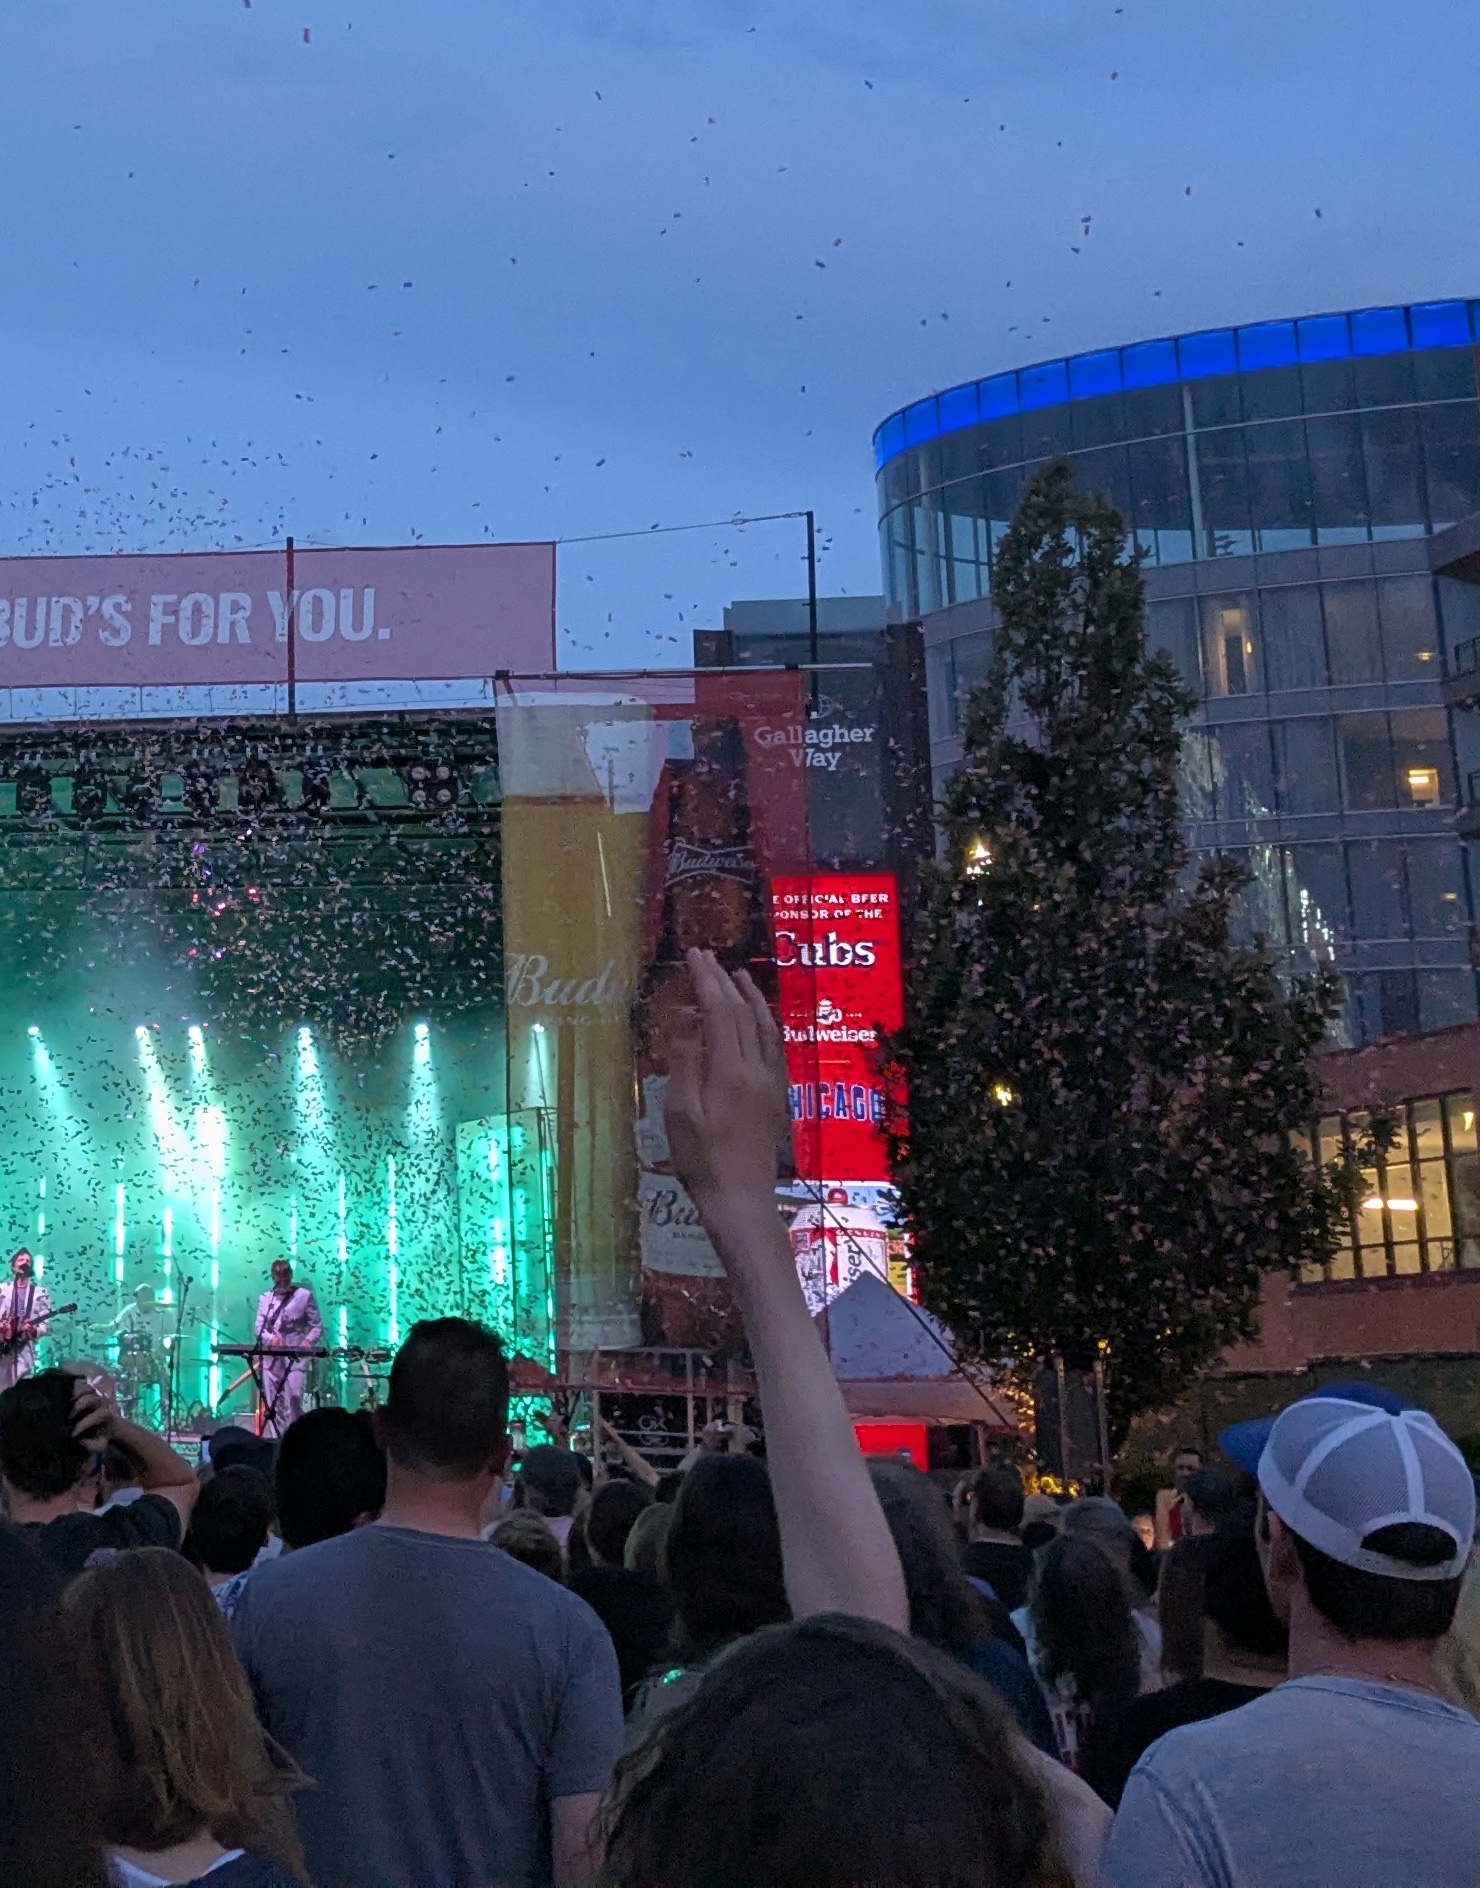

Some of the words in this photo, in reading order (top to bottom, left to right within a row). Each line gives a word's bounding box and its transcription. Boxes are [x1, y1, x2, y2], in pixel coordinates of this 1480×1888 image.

[148, 592, 253, 646] FOR
[267, 588, 391, 644] YOU.
[754, 724, 875, 748] Gallagher
[787, 747, 842, 771] Way
[850, 893, 889, 905] BEER
[773, 909, 829, 919] PONSOR
[774, 931, 876, 967] Cubs
[787, 1082, 886, 1123] HICAGO
